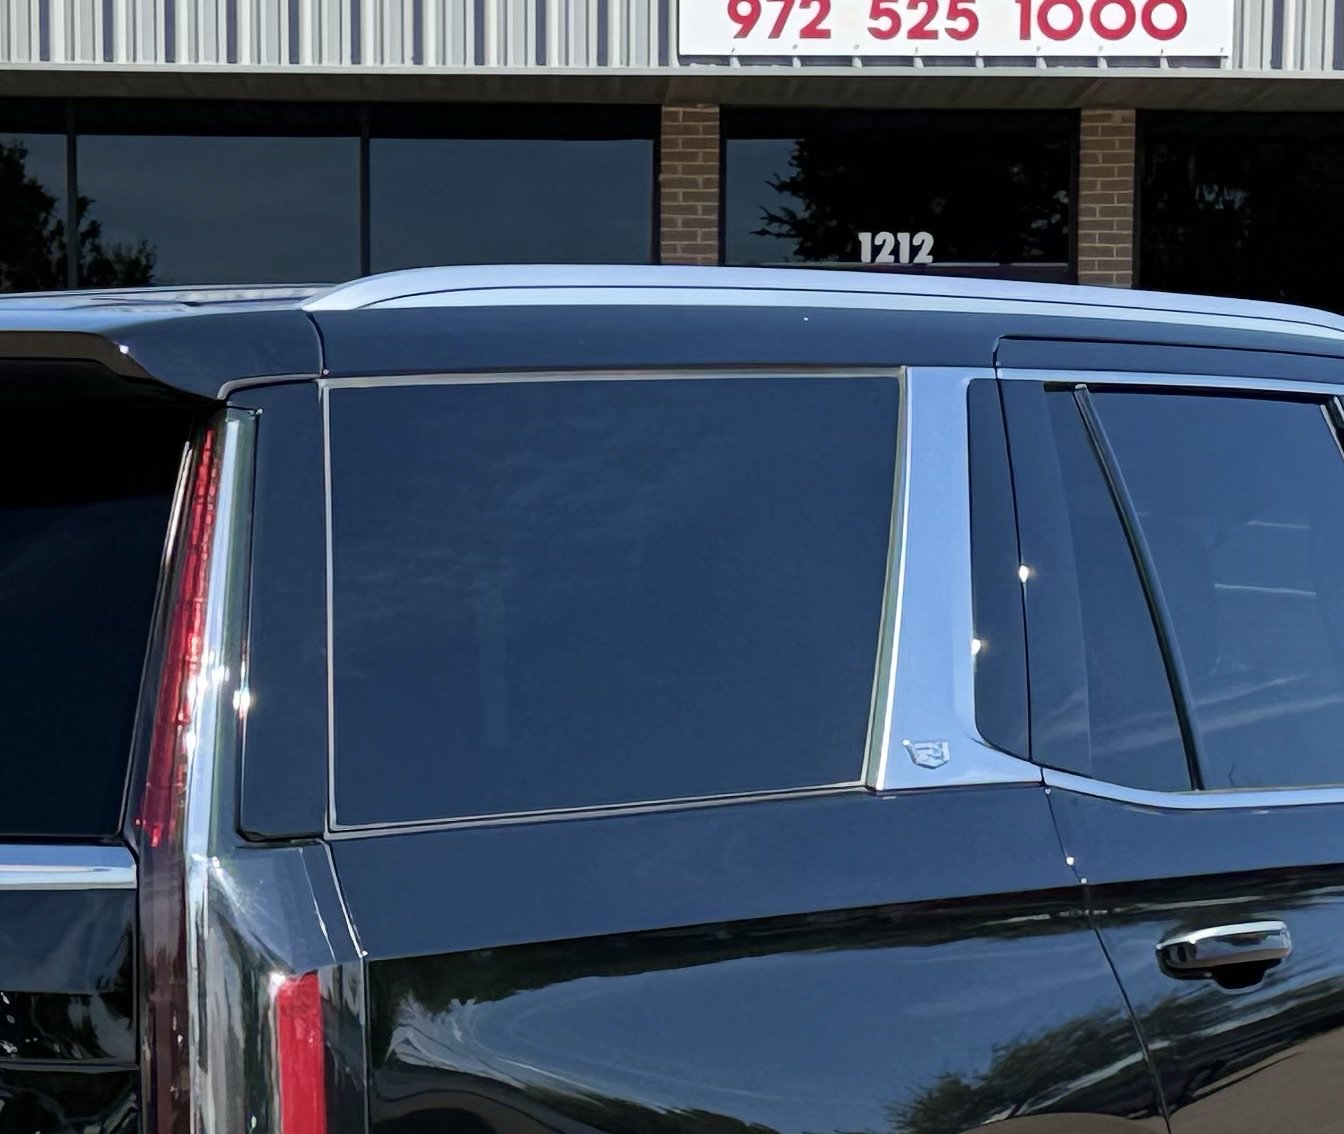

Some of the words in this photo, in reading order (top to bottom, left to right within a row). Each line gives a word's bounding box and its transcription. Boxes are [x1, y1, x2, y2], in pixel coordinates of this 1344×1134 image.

[727, 0, 832, 39] 972
[867, 0, 980, 40] 525
[1015, 0, 1188, 41] 1000
[858, 231, 934, 264] 1212
